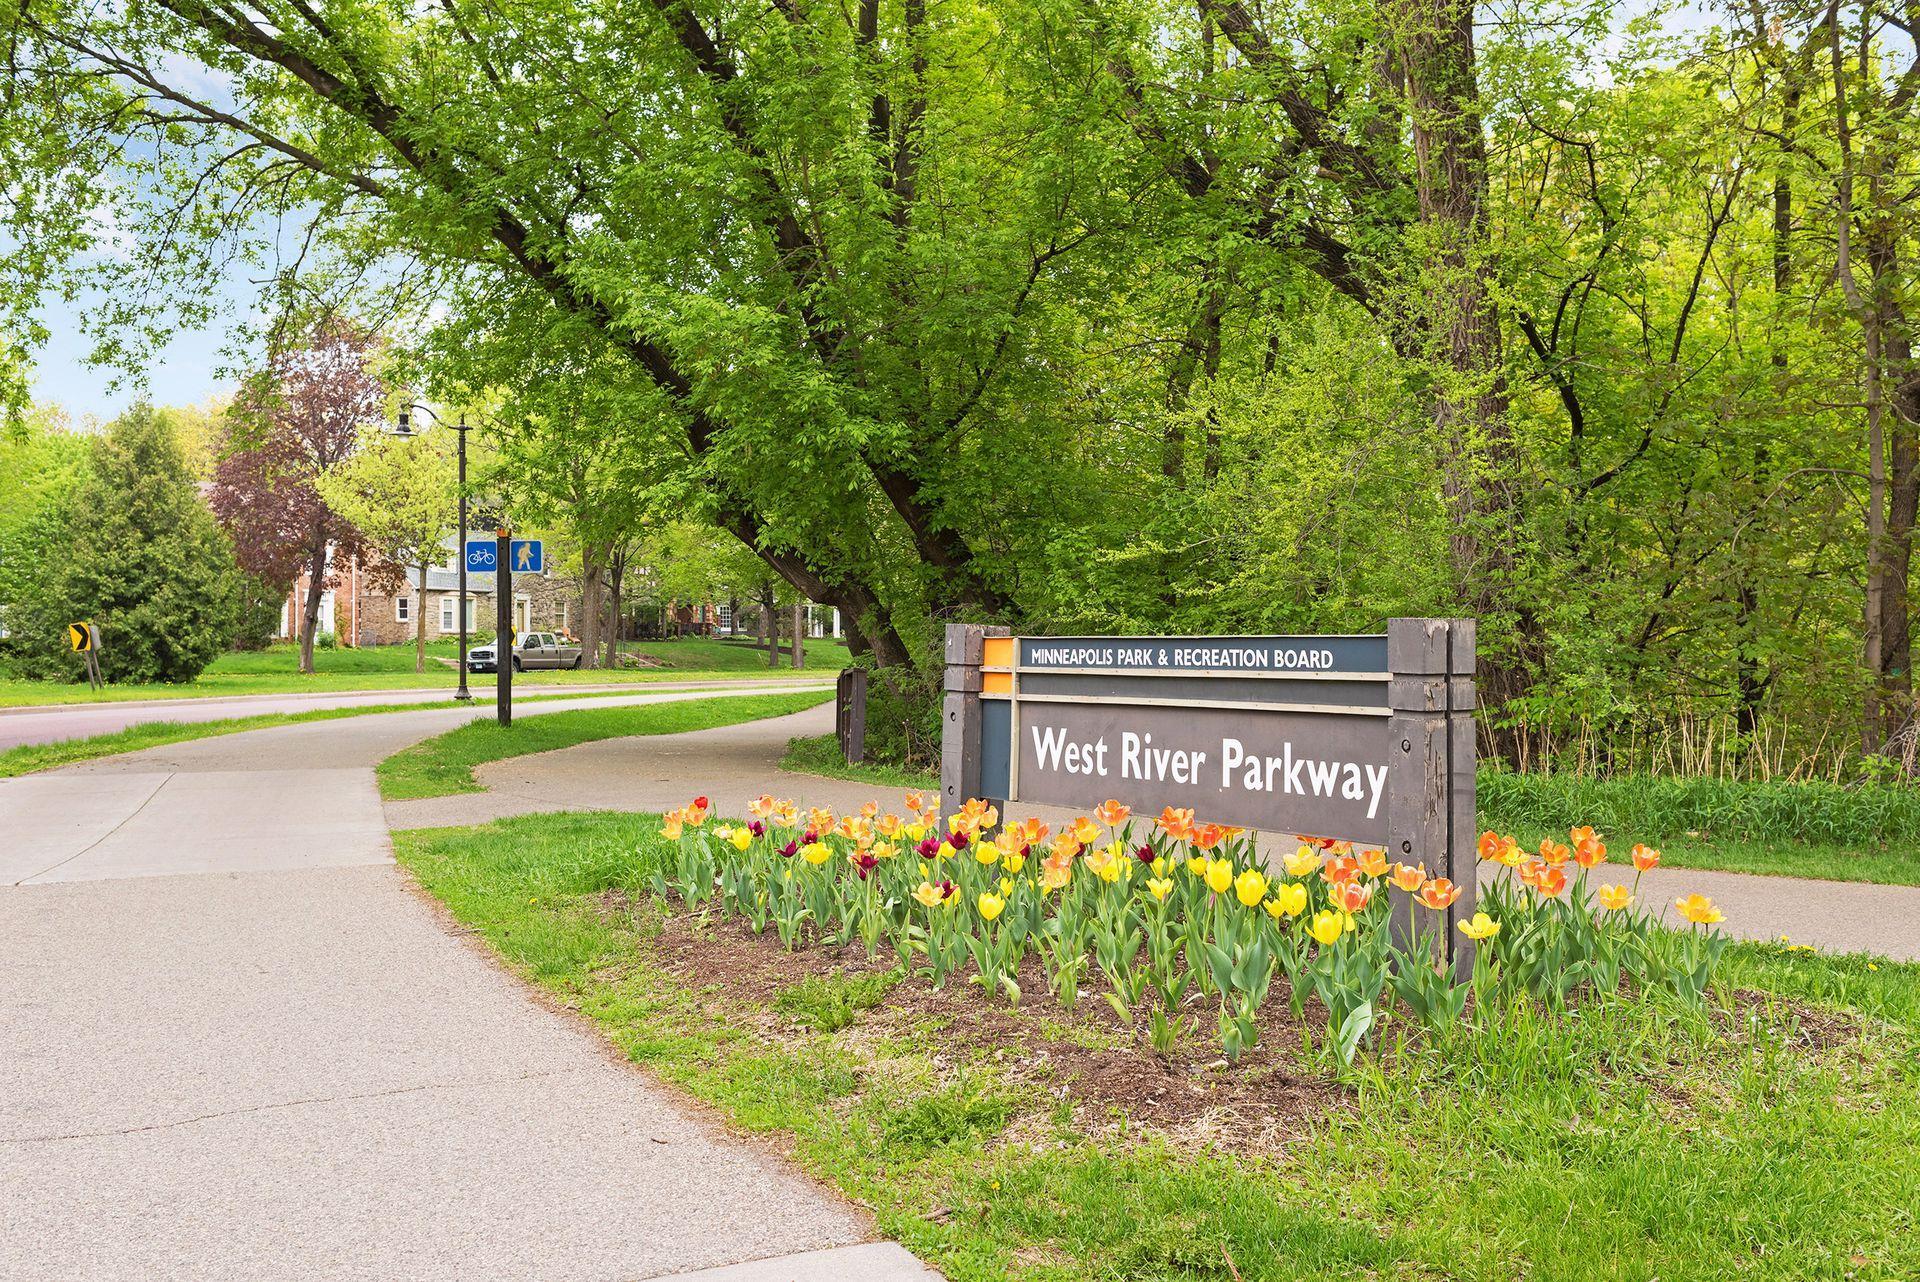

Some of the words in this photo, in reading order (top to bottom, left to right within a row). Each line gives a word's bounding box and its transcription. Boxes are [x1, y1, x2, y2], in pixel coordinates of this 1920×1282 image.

[1031, 648, 1113, 666] MINNEAPOLIS
[1117, 648, 1153, 666] PARK
[1157, 648, 1169, 666] &
[1174, 648, 1268, 668] RECREATION
[1274, 649, 1334, 669] BOARD
[1031, 725, 1108, 777] West
[1121, 731, 1207, 785] River
[1222, 737, 1389, 820] Parkway
